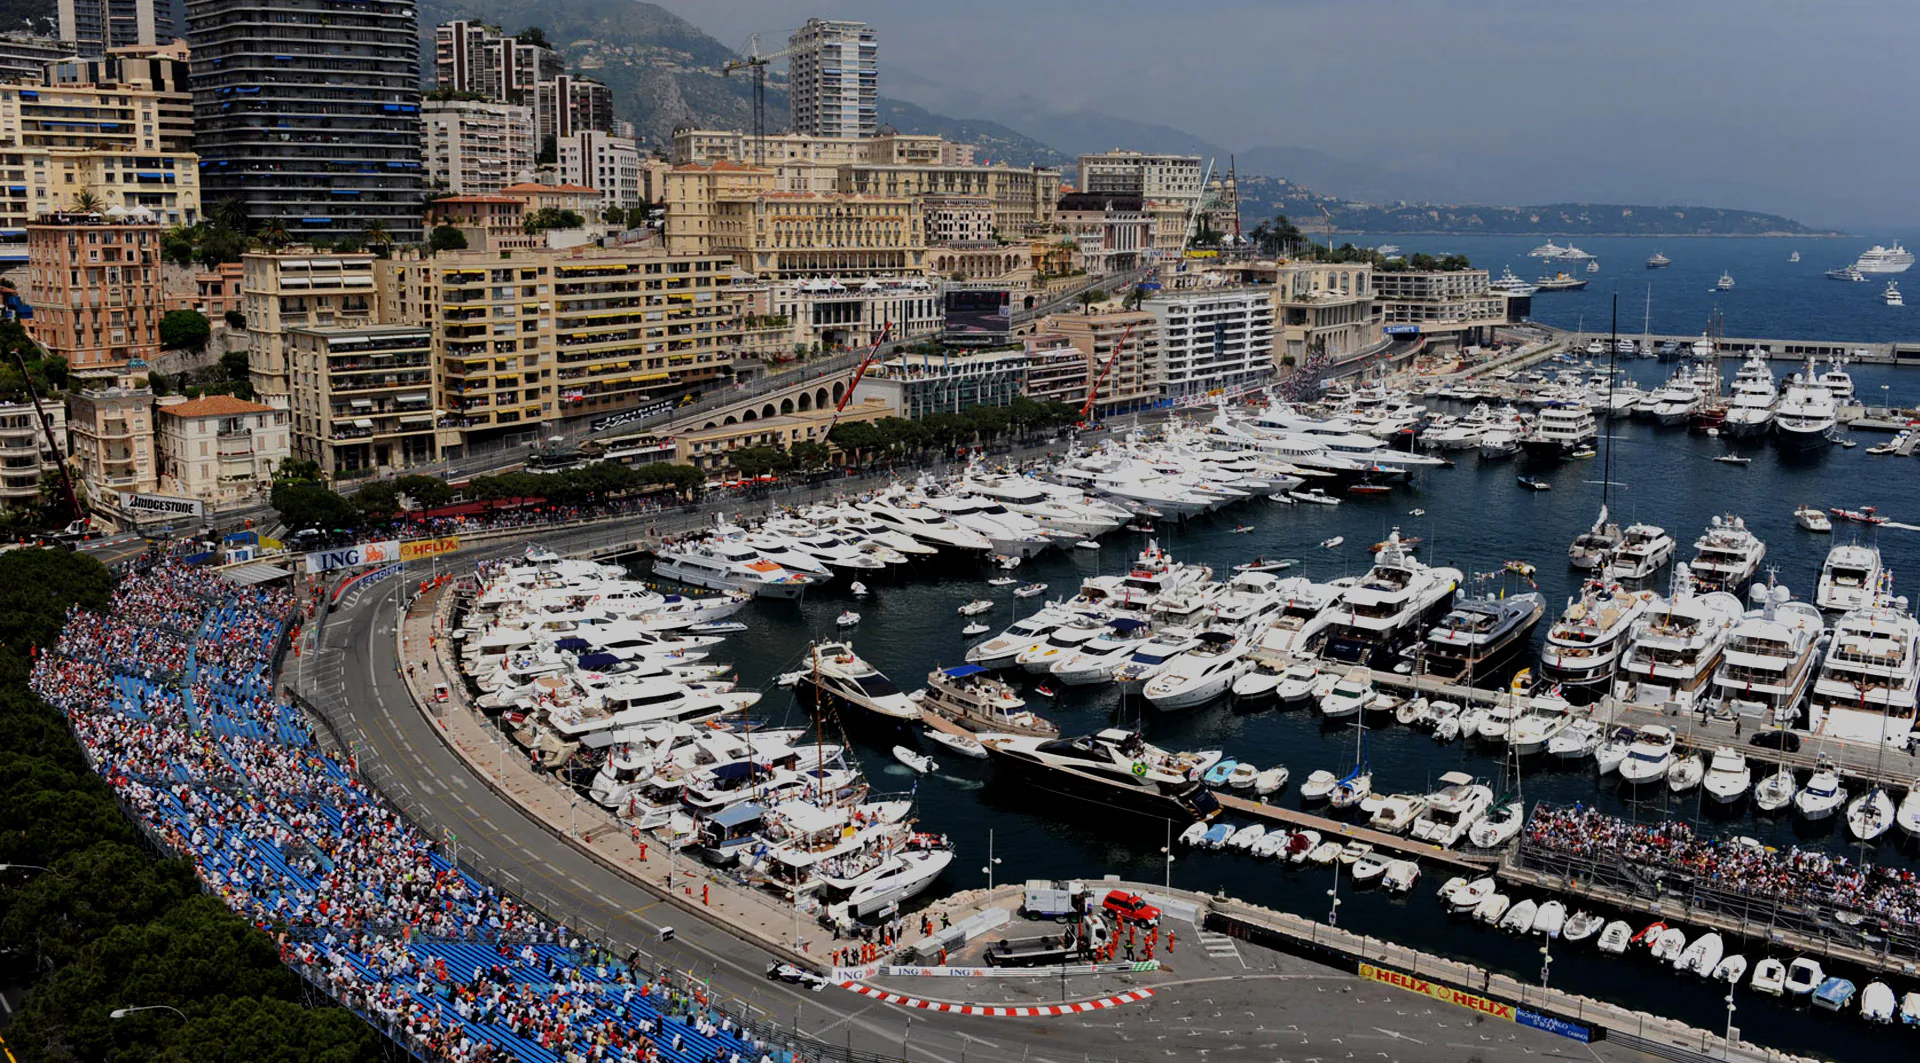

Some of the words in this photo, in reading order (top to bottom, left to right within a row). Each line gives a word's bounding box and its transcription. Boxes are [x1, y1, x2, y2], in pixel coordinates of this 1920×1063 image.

[594, 400, 673, 426] JOHNNIE
[129, 494, 194, 514] BRIDGESTONE
[413, 540, 456, 554] HELIX
[322, 549, 360, 569] ING
[838, 970, 863, 980] ING
[899, 968, 919, 976] ING
[950, 968, 970, 977] ING
[1376, 969, 1430, 994] HELIX
[1453, 991, 1509, 1019] HELIX
